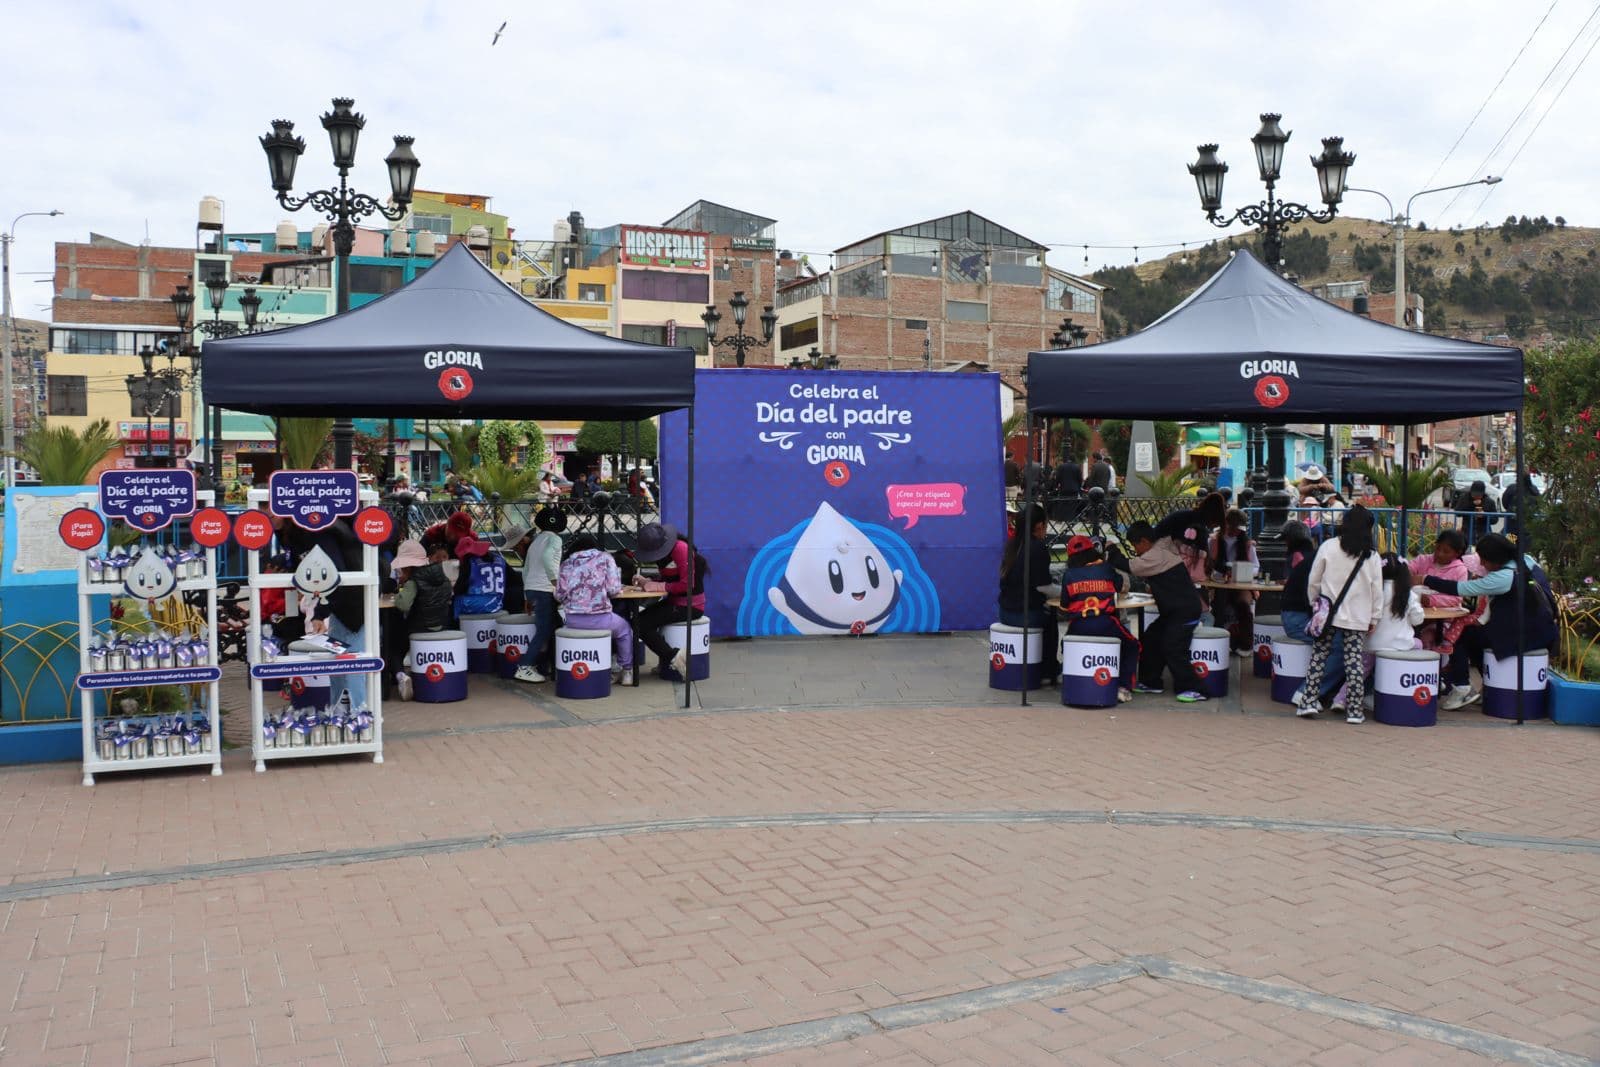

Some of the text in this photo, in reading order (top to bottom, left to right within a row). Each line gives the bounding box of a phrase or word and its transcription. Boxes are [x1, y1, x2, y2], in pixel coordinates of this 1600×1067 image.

[625, 230, 706, 260] HOSPEDAJE
[424, 351, 484, 370] GLORIA
[1240, 360, 1300, 379] GLORIA
[789, 384, 879, 400] Celebra el
[756, 402, 912, 428] Día del padre
[825, 431, 846, 440] con
[806, 445, 866, 466] GLORIA
[123, 476, 171, 484] Celebra el
[292, 477, 336, 485] Celebra el
[106, 485, 188, 497] Día del padre
[276, 486, 352, 498] Día del padre
[132, 505, 164, 515] GLORIA
[300, 505, 329, 515] GLORIA
[71, 523, 93, 531] ¡Para
[200, 521, 221, 529] ¡Para
[71, 530, 94, 538] Papá!
[480, 566, 504, 593] 32
[477, 629, 497, 642] GLO
[498, 634, 530, 646] GLORIA
[416, 651, 455, 666] GLORIA
[561, 650, 600, 664] GLORIA
[1082, 655, 1119, 670] GLORIA
